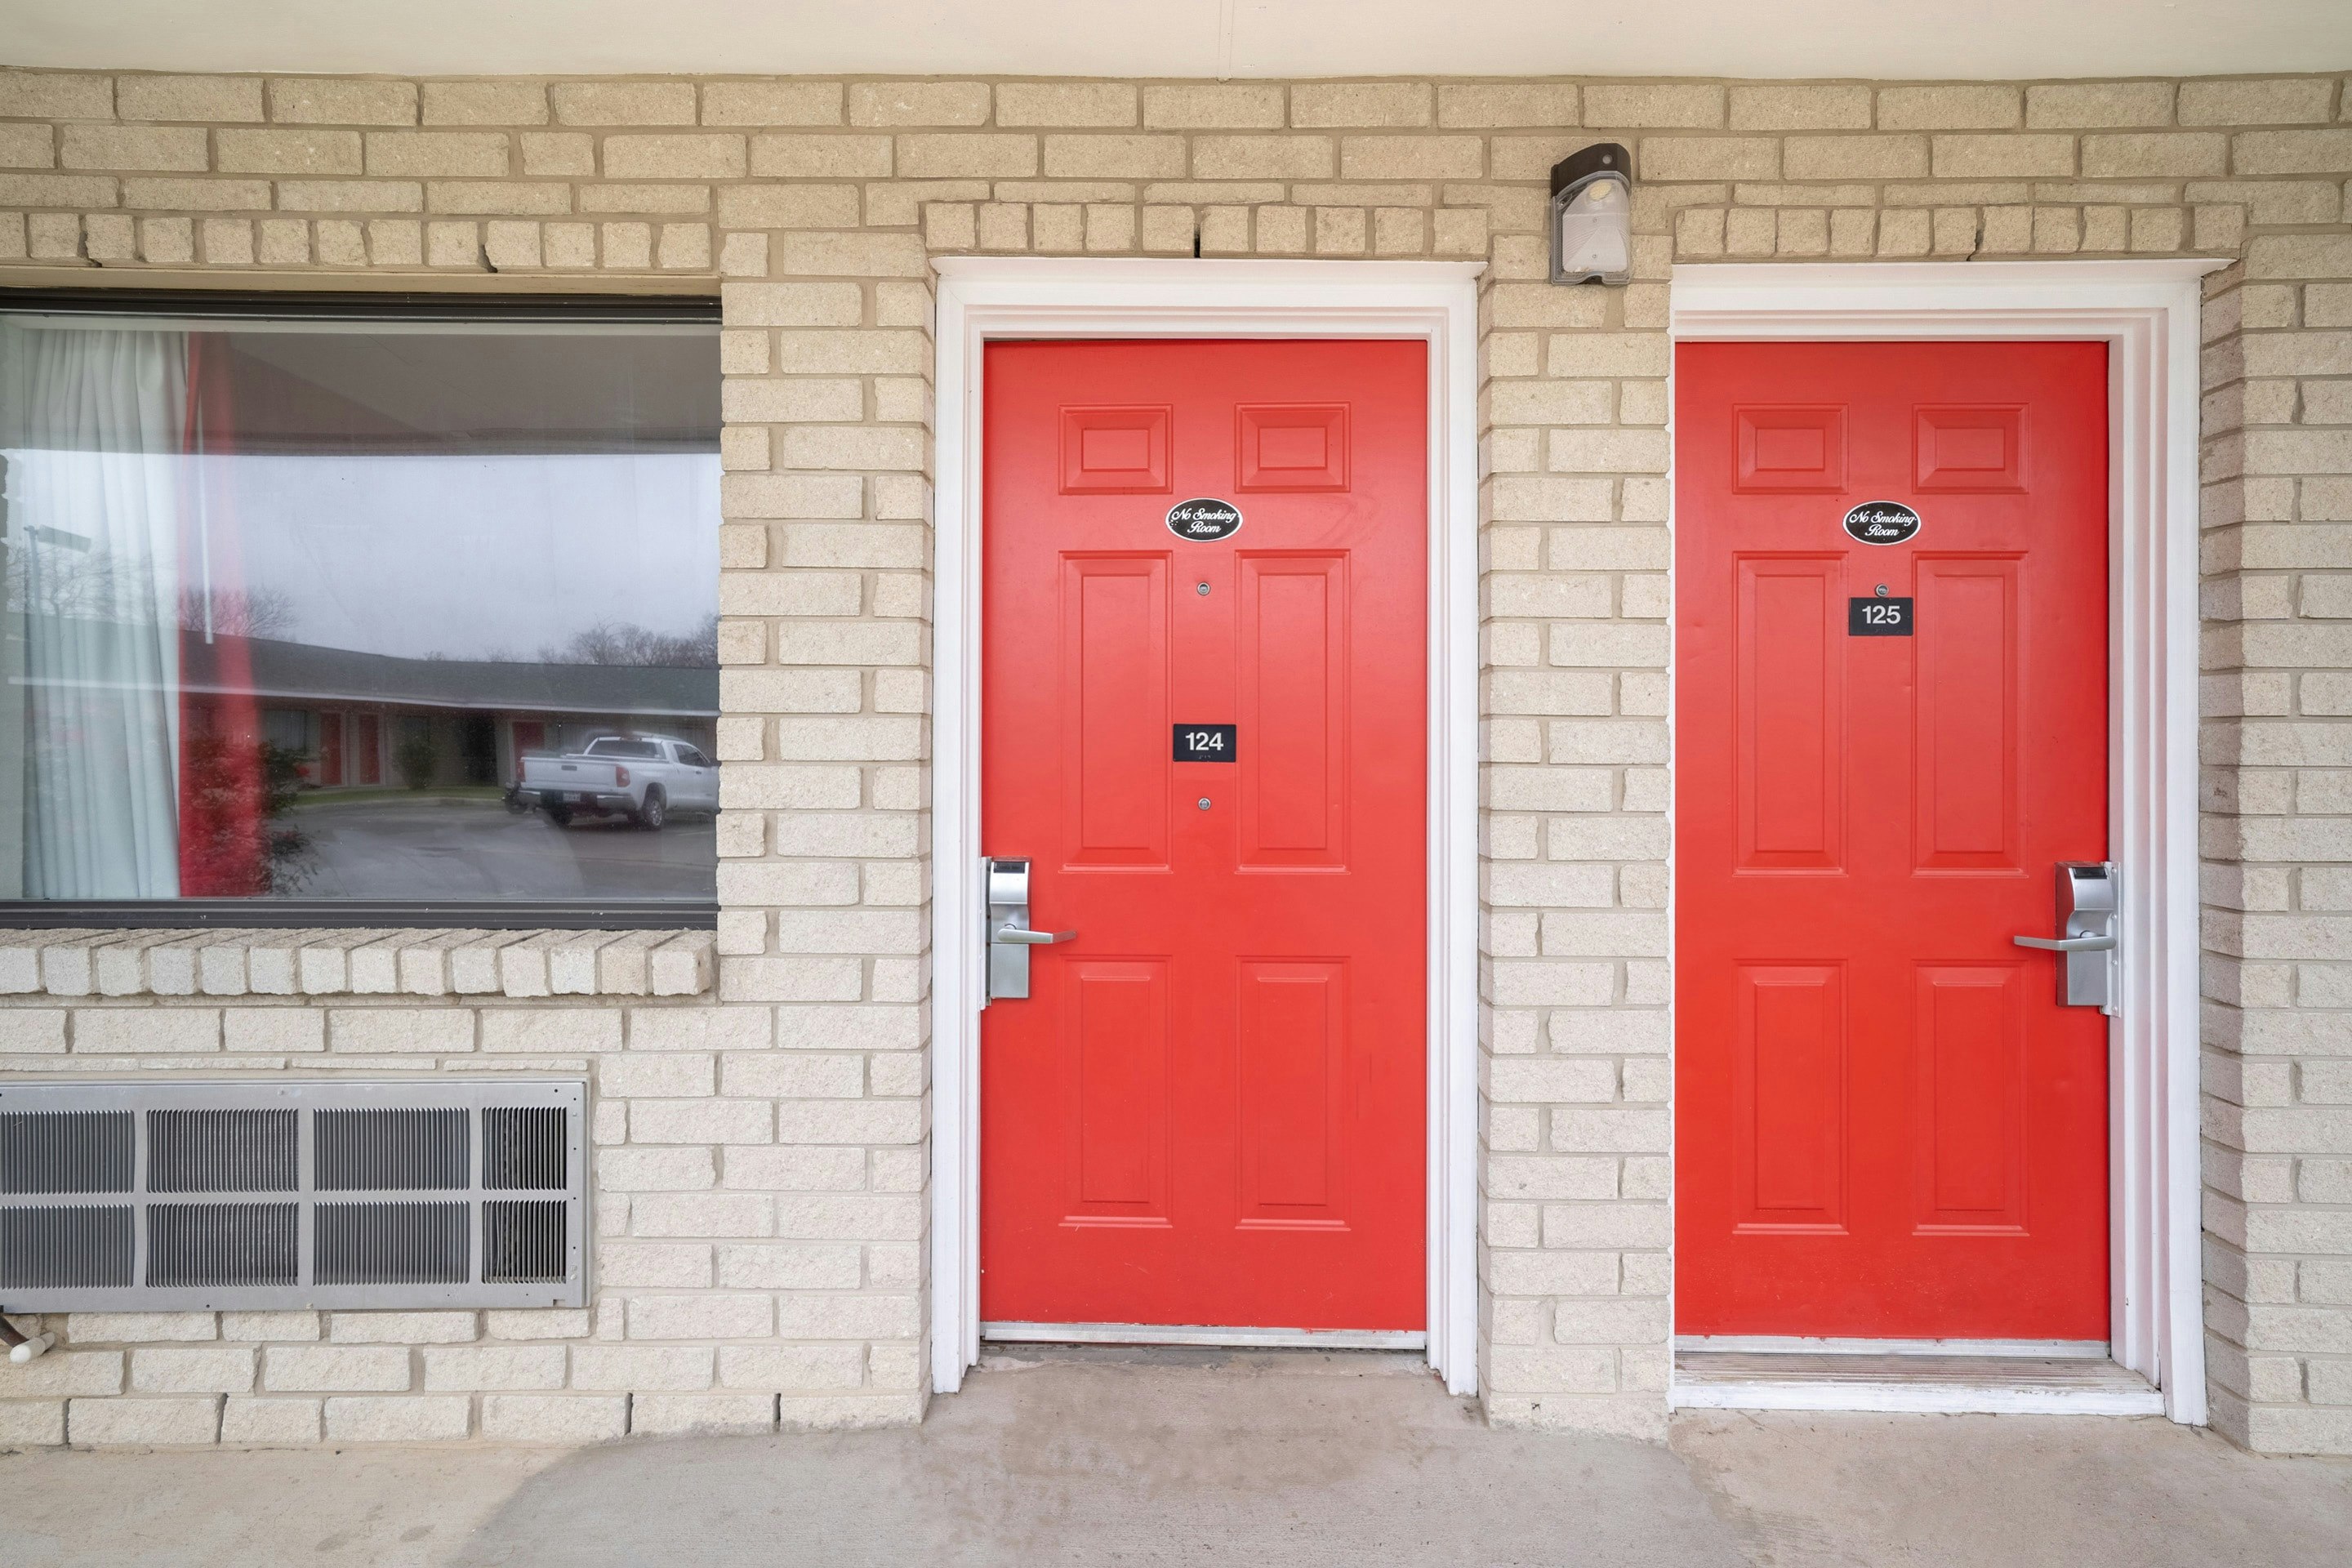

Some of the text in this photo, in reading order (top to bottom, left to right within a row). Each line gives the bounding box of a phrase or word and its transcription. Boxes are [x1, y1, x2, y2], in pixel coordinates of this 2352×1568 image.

[1171, 508, 1236, 523] No Smoking
[1849, 510, 1916, 527] No Smoking
[1187, 521, 1221, 532] Room
[1864, 524, 1899, 536] Room
[1862, 605, 1900, 624] 125
[1185, 732, 1224, 751] 124
